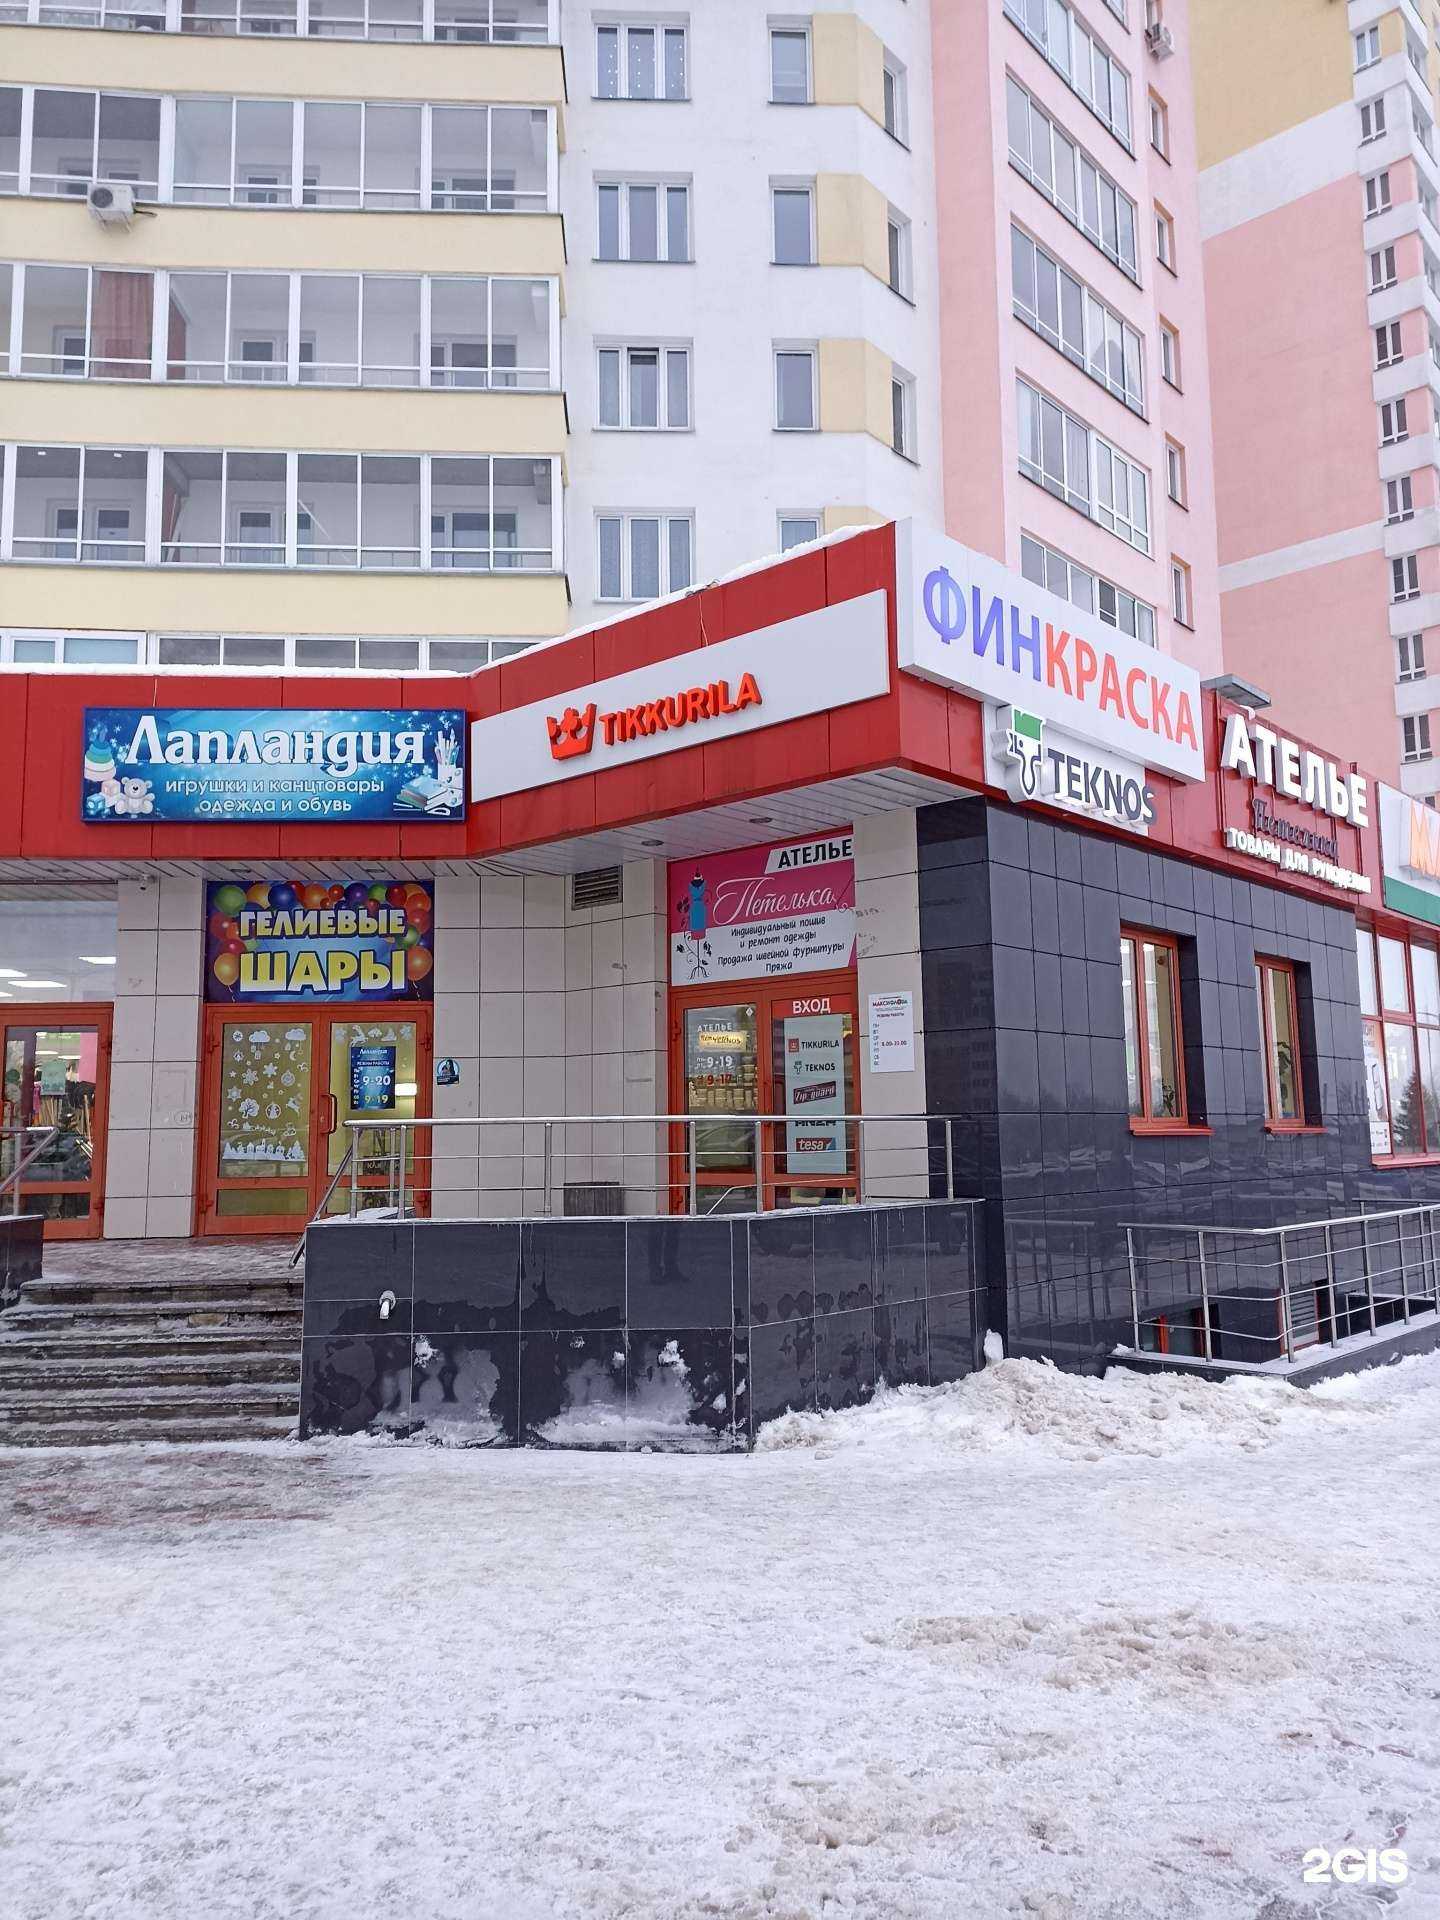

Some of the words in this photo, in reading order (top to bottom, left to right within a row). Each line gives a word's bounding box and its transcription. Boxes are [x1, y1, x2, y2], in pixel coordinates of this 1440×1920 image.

[922, 565, 1199, 752] ФИНКРАСКА
[599, 672, 763, 746] TIKKURILA
[124, 715, 426, 777] Лапландия
[1222, 713, 1369, 828] АТЕЛЬЕ
[165, 778, 247, 795] игрушки
[252, 781, 263, 793] и
[268, 778, 385, 795] канцтовары
[1047, 747, 1158, 826] TEKNOS
[199, 798, 276, 814] одежда
[281, 799, 292, 812] и
[297, 797, 352, 814] обувь
[1226, 827, 1281, 864] ТОВАРЫ
[1284, 848, 1309, 873] ДЛЯ
[1409, 798, 1440, 879] М
[777, 838, 852, 869] АТЕЛЬЕ
[713, 877, 836, 926] Петелька
[239, 909, 405, 937] ГЕЛИЕВЫЕ
[731, 919, 796, 938] Индивидуальный
[799, 916, 826, 928] пошив
[748, 935, 780, 949] ремонт
[783, 931, 817, 945] одежды
[717, 953, 753, 967] Продажа
[756, 947, 789, 961] швейной
[792, 942, 845, 959] фурнитуры
[765, 961, 793, 974] Пряжа
[239, 950, 406, 992] ШАРЫ
[792, 998, 831, 1014] ВХОД
[697, 1022, 733, 1033] АТЕЛЬЕ
[800, 1039, 840, 1050] TIKKURILA
[804, 1062, 836, 1072] TEKNOS
[798, 1138, 824, 1150] tesa
